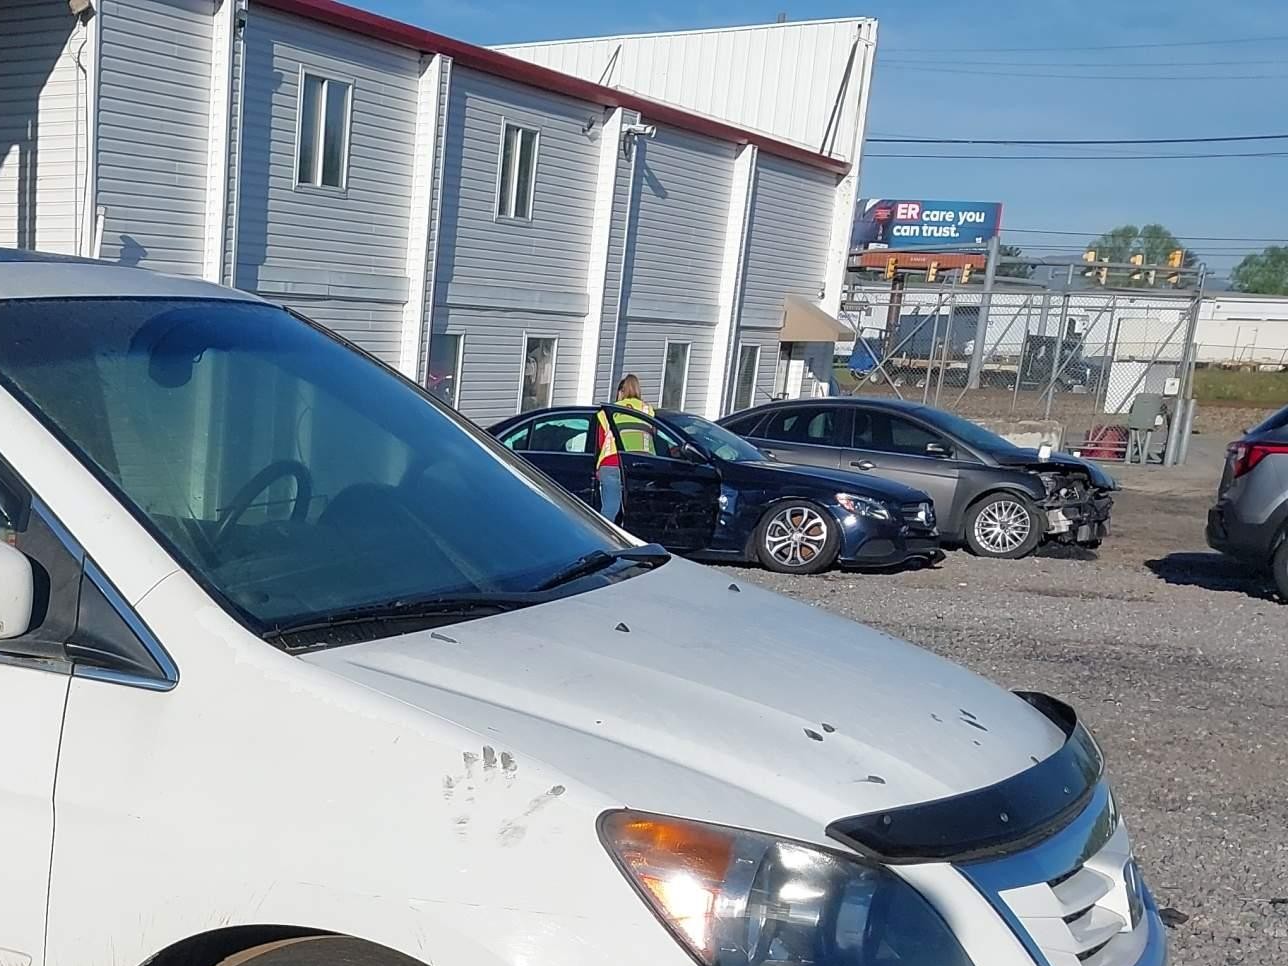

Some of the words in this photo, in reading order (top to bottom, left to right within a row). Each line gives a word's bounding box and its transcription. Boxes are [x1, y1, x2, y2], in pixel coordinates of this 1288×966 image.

[897, 204, 919, 219] ER
[922, 210, 954, 222] care
[958, 211, 984, 224] you
[893, 225, 919, 236] can
[922, 224, 960, 237] trust.
